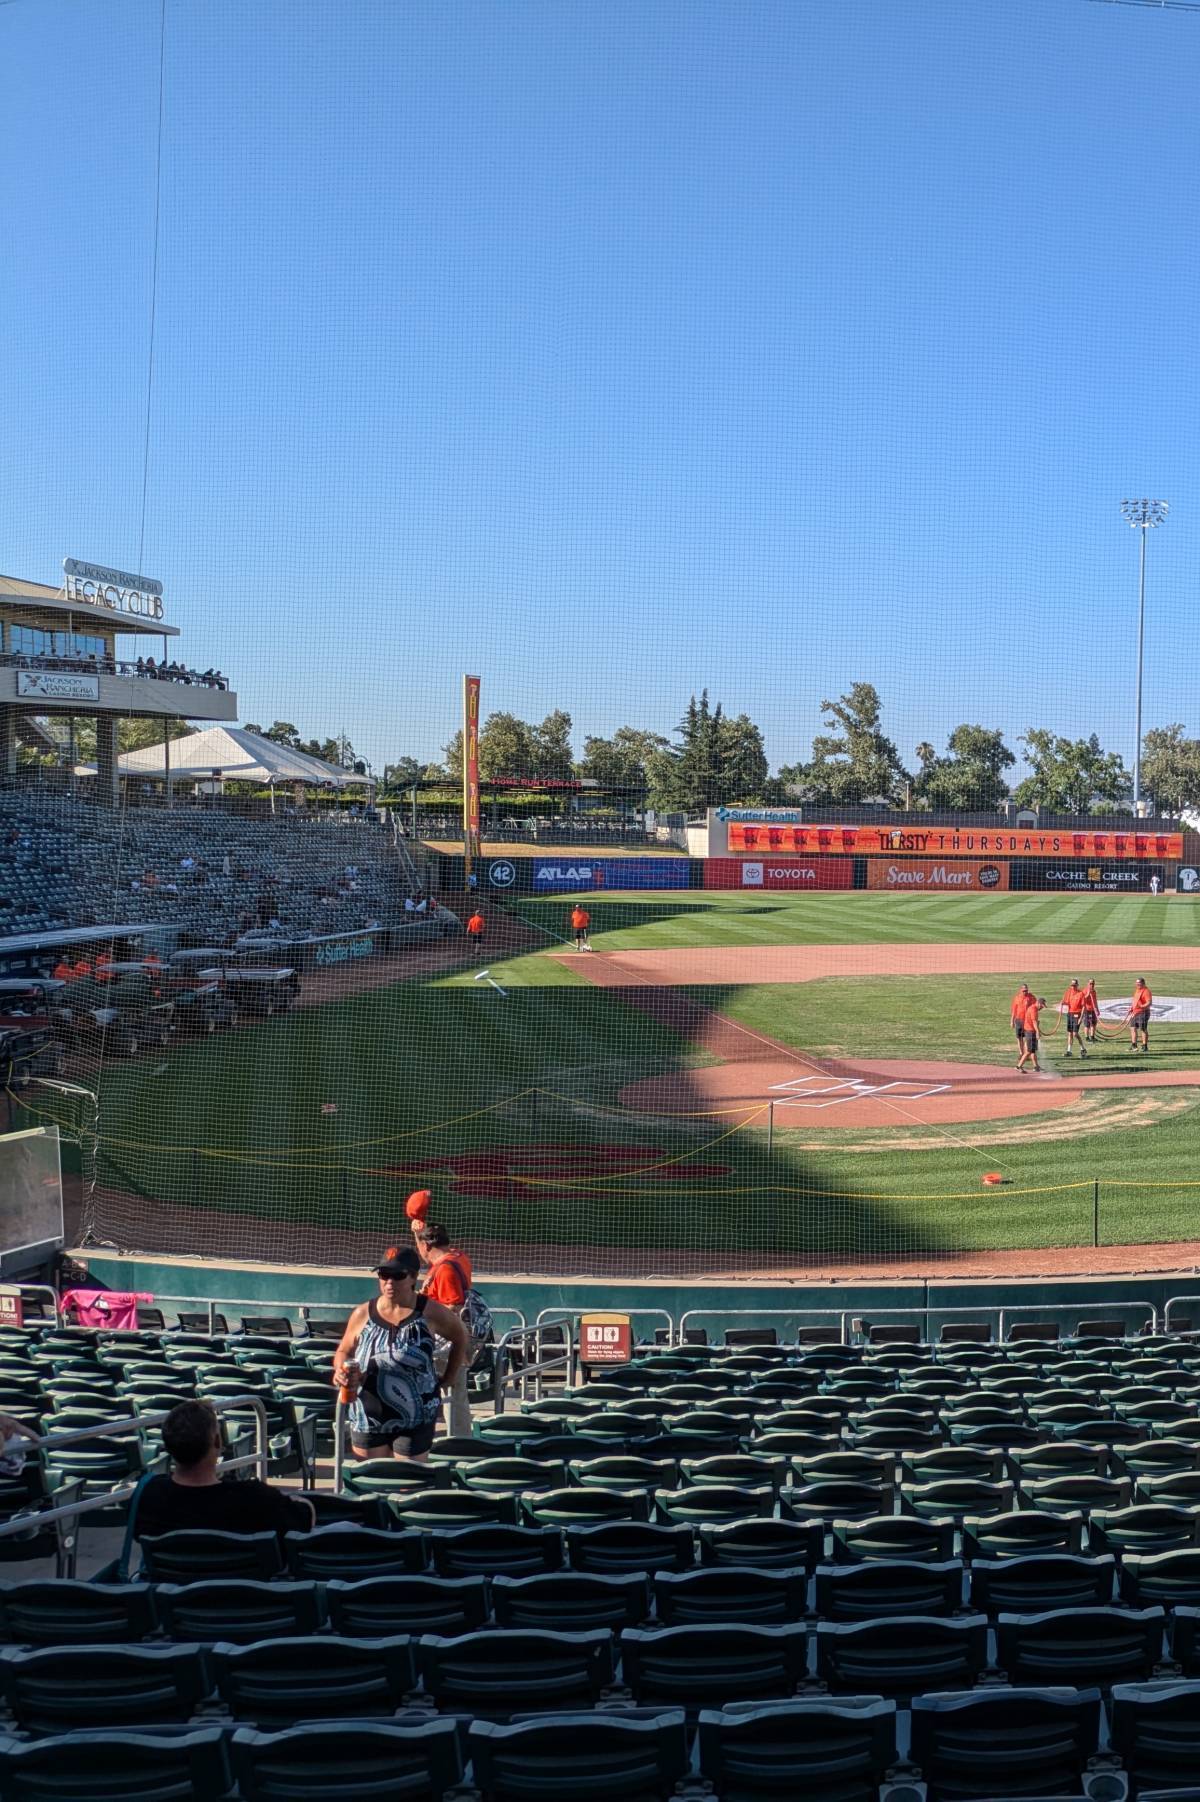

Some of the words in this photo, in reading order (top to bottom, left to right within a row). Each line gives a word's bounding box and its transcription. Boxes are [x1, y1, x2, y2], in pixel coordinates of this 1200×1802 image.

[66, 576, 126, 610] LEGACY
[128, 591, 163, 619] CLUB
[41, 675, 82, 685] JACKSON
[491, 777, 516, 785] HOME
[521, 778, 540, 786] RUN
[731, 811, 763, 820] Sutter
[764, 811, 797, 821] Health
[939, 835, 1060, 851] THURSDAYS
[493, 866, 510, 881] 42
[536, 867, 592, 881] ATLAS
[768, 869, 816, 879] TOYOTA
[887, 865, 925, 884] Save
[928, 866, 972, 884] Mart
[1046, 871, 1087, 880] CACHE
[1102, 872, 1140, 881] CREEK
[325, 944, 348, 961] Sutter
[350, 938, 373, 957] Health
